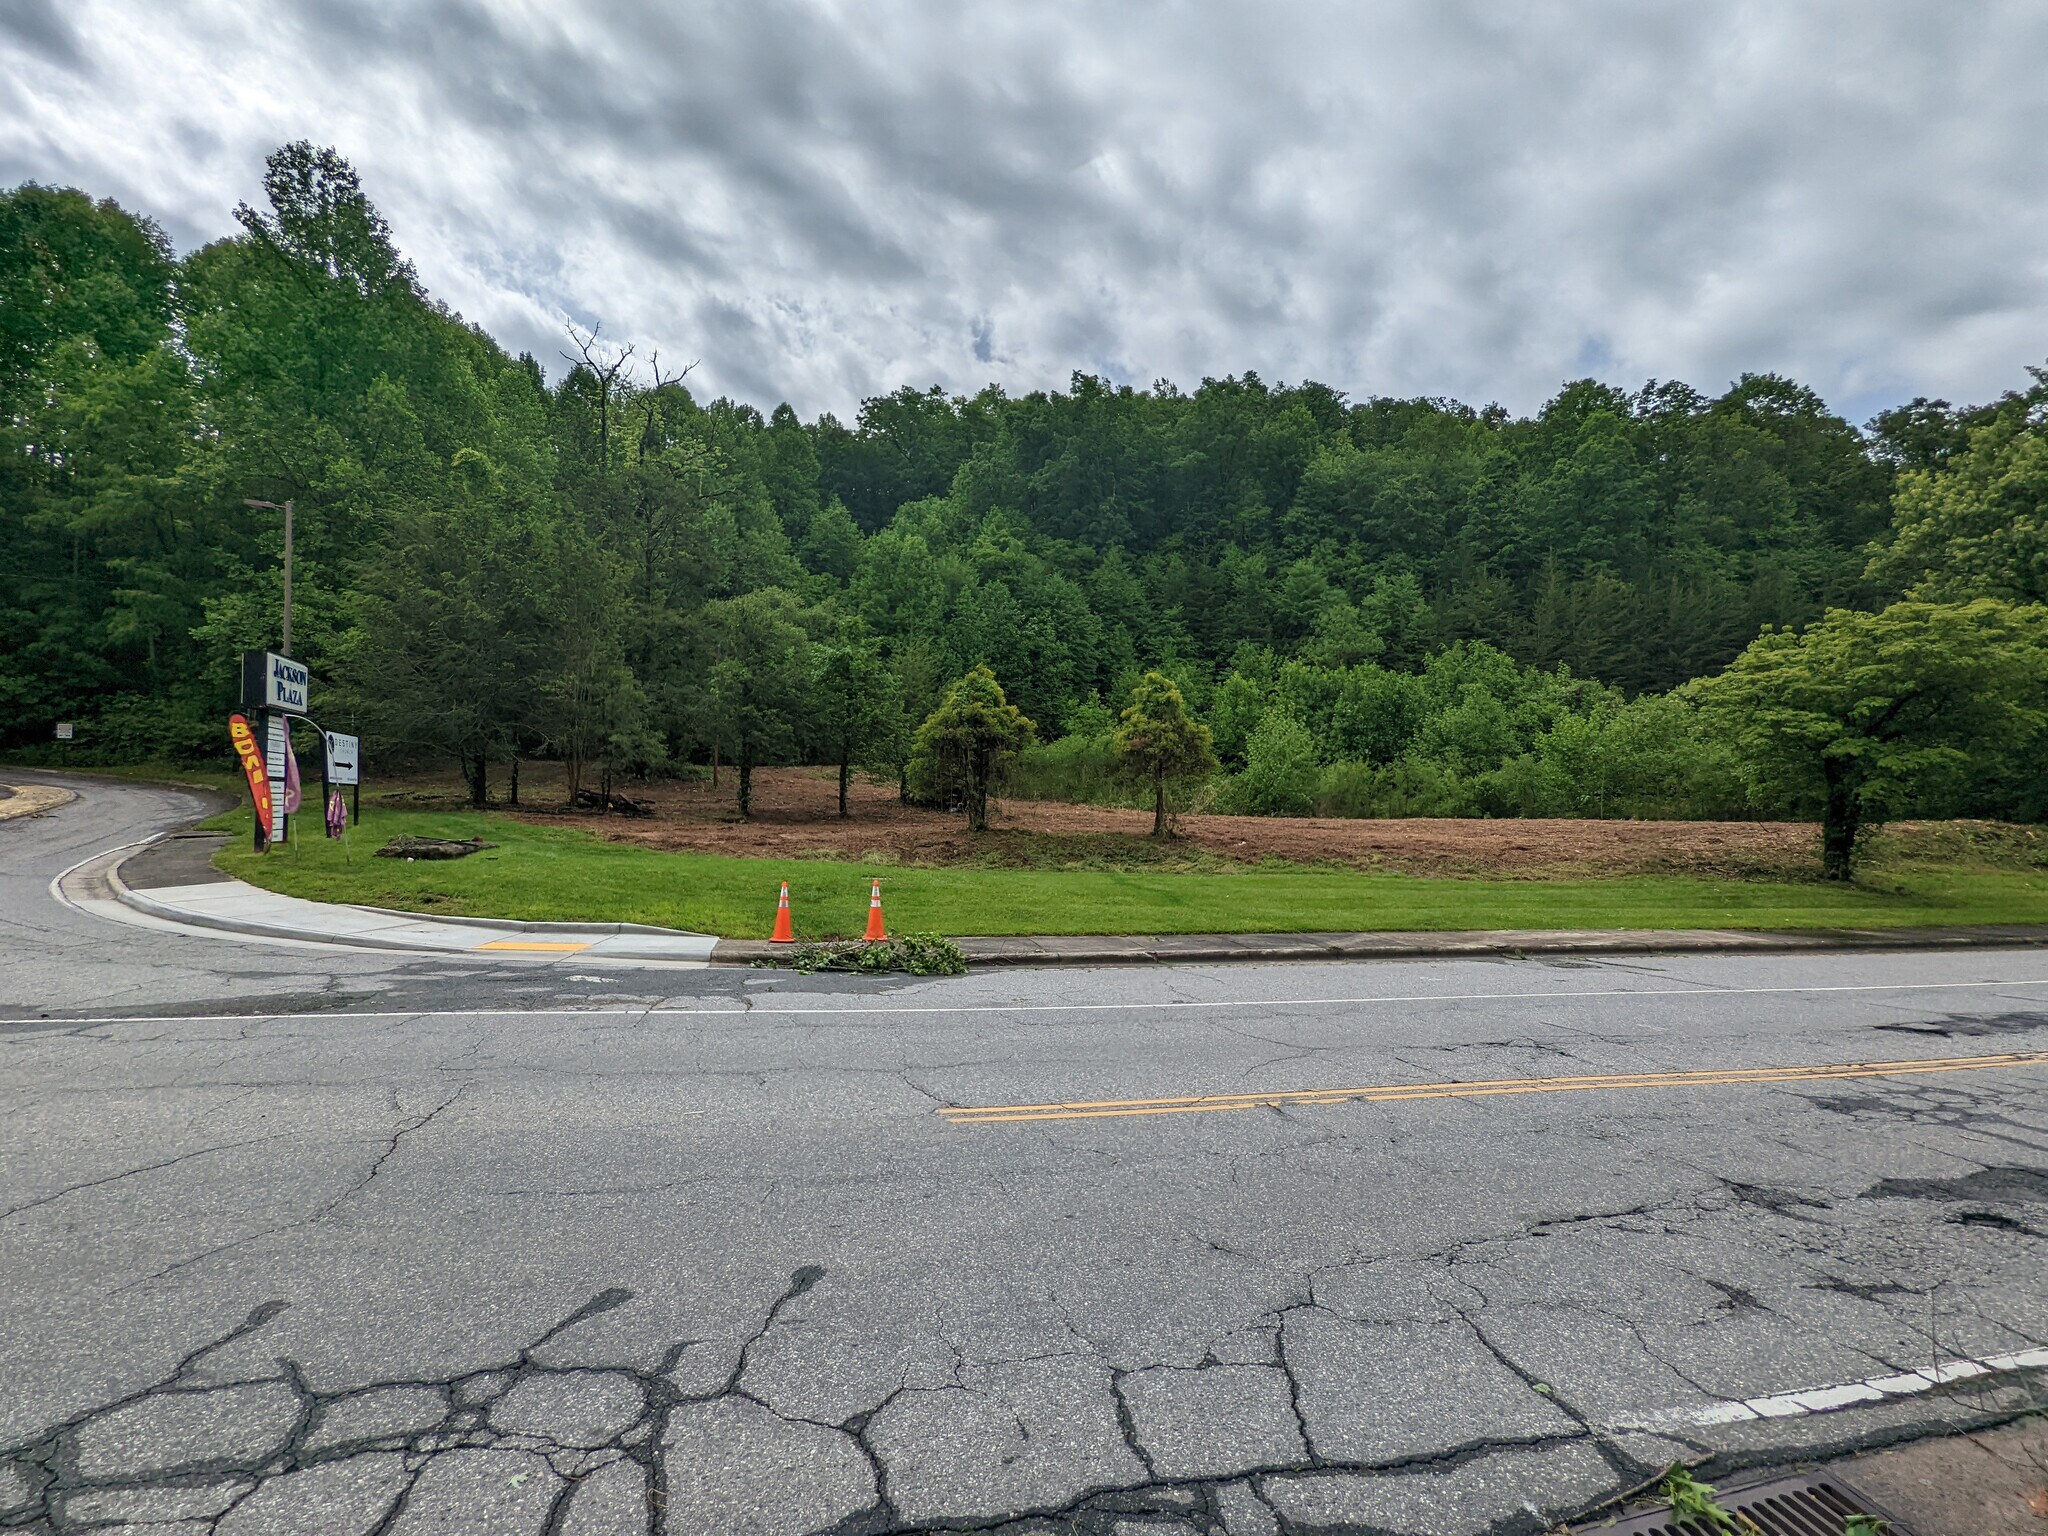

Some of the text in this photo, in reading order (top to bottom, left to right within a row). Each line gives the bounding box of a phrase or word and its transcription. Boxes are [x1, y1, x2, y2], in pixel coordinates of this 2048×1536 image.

[273, 658, 306, 686] JACKSON
[276, 680, 302, 706] PLAZA
[335, 738, 358, 750] DESTINY
